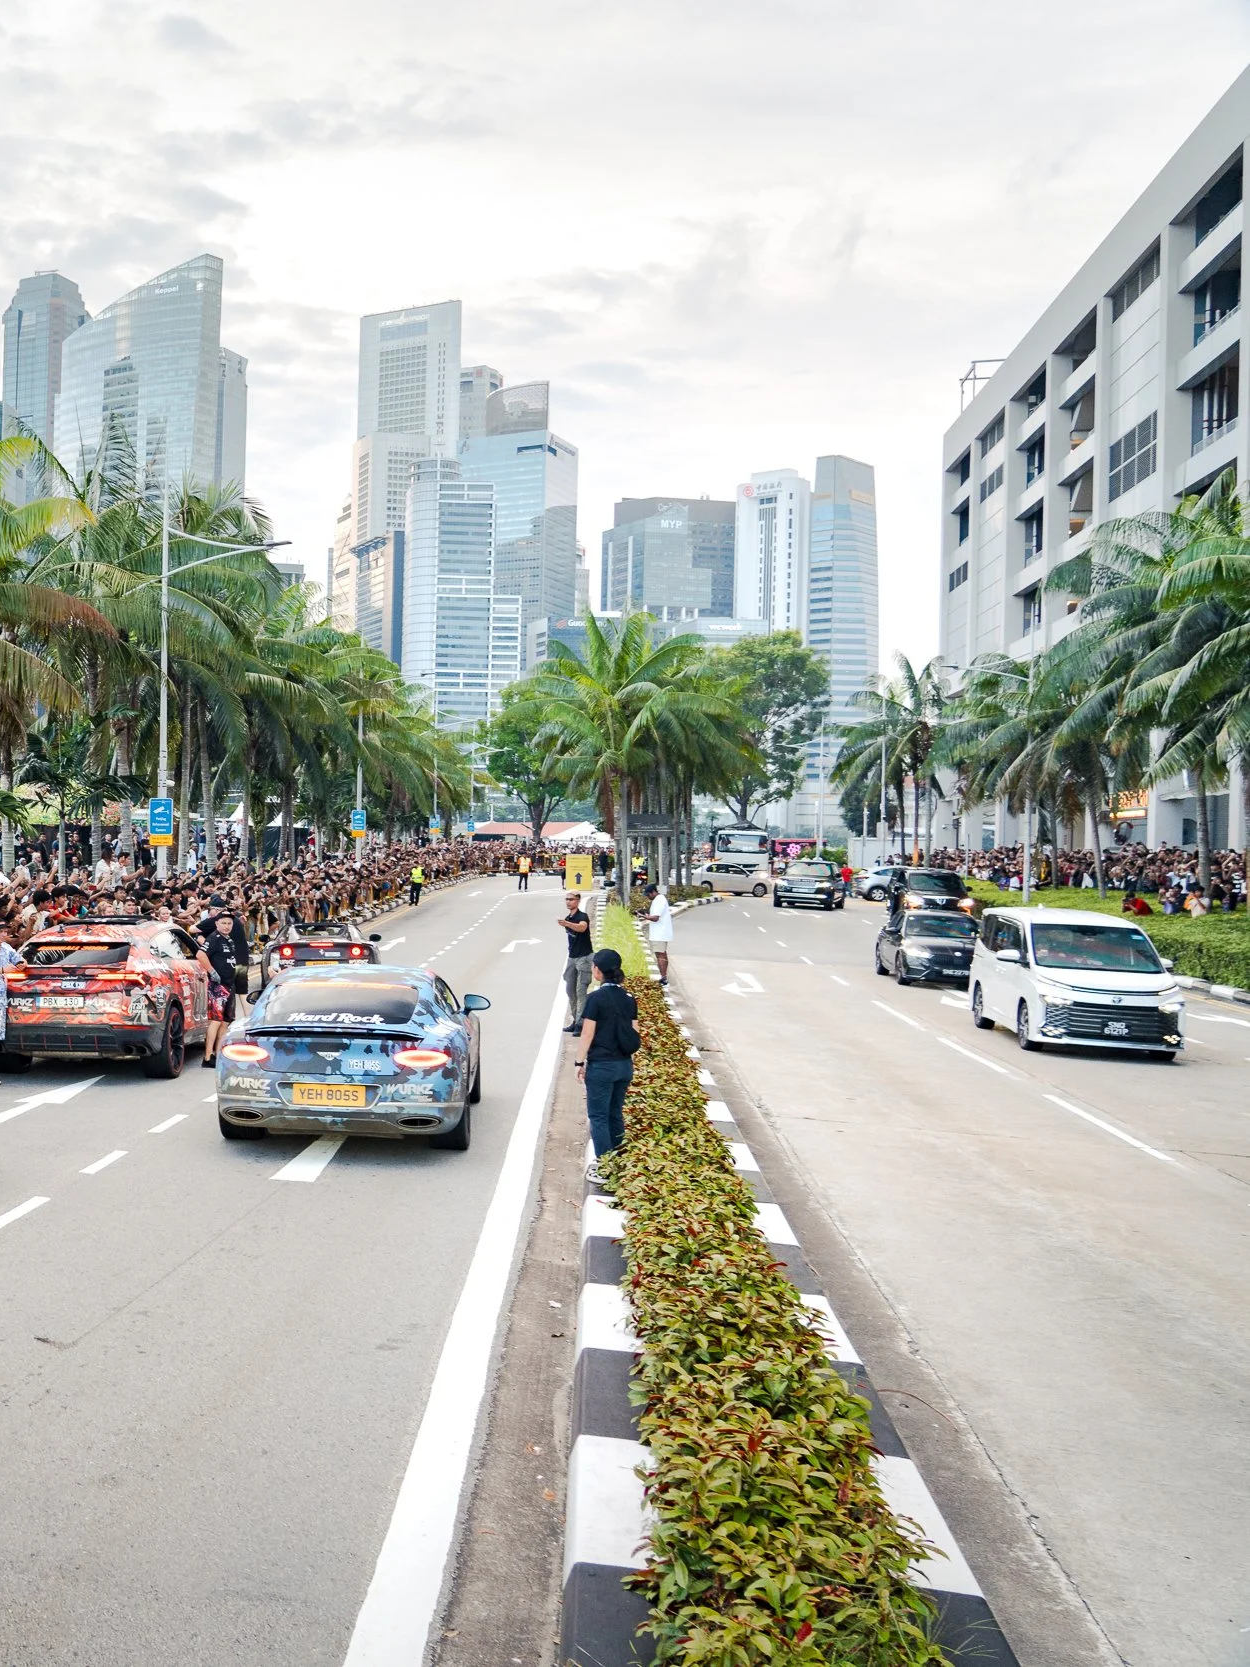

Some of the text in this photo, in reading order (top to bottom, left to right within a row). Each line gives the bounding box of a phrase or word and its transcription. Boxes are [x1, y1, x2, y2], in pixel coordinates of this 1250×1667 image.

[154, 285, 179, 294] Keppel
[660, 519, 682, 529] MYP
[709, 622, 743, 631] wework
[43, 997, 79, 1006] PBX 130
[287, 1012, 385, 1024] Hard Rock
[230, 1076, 271, 1090] WURKZ
[386, 1083, 434, 1095] WURKZ
[299, 1088, 359, 1102] YEH 805S
